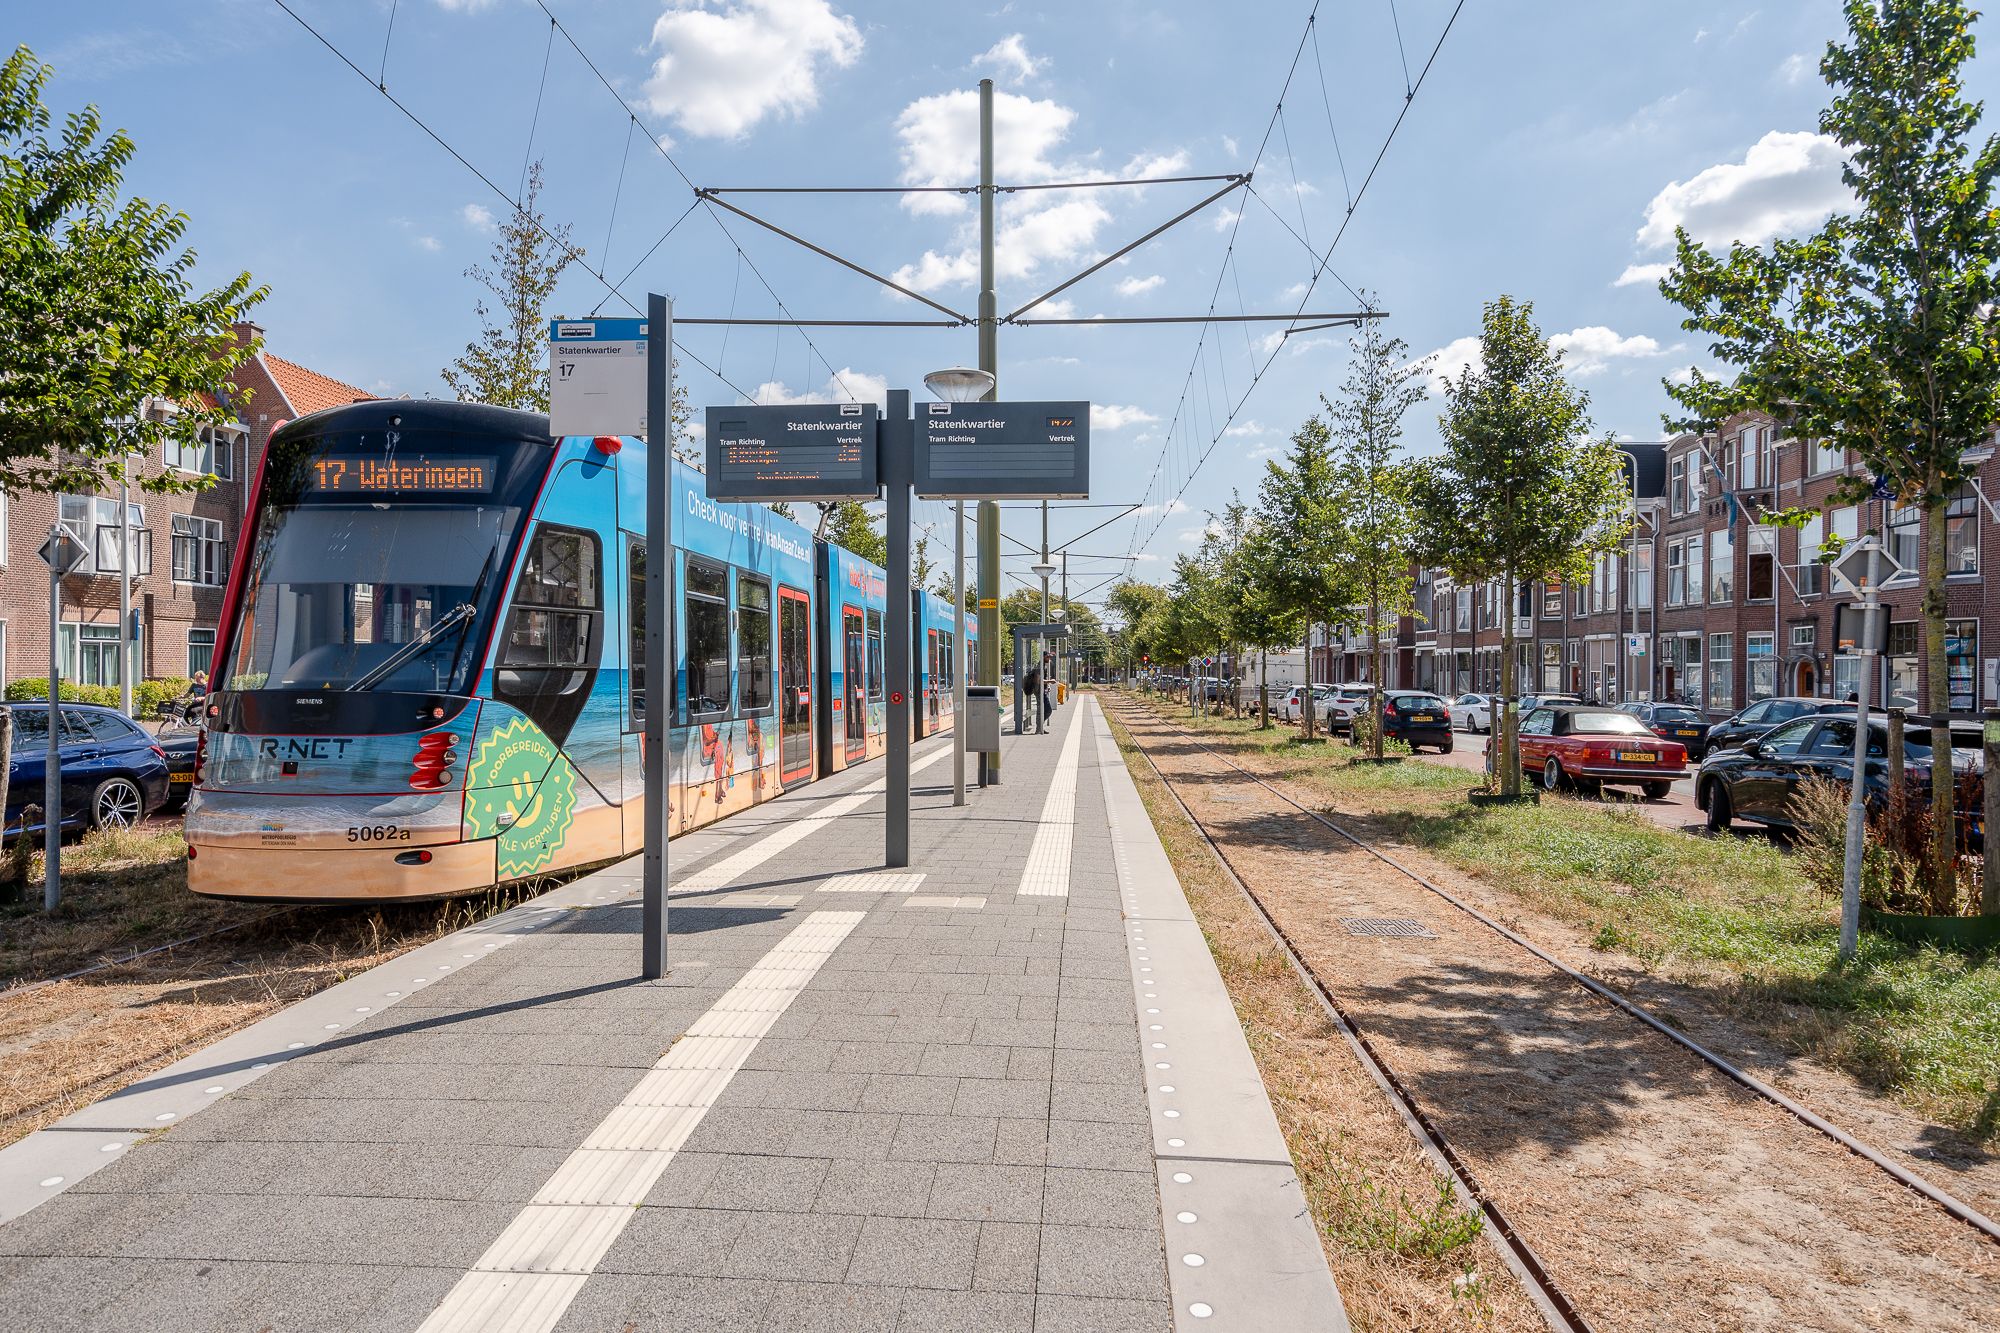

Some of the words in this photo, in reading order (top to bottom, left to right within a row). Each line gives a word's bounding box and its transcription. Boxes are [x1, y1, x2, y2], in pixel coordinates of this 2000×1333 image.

[559, 346, 621, 355] Statenkwartier
[559, 364, 575, 376] 17
[787, 421, 862, 431] Statenkwartier
[928, 420, 1006, 429] Statenkwartier
[738, 438, 766, 446] Richting
[948, 435, 976, 443] Richting
[314, 460, 347, 489] 17
[361, 460, 482, 489] Wateringen
[688, 490, 718, 524] Check
[718, 510, 737, 532] voor
[520, 792, 562, 852] VERMIJDEN
[347, 825, 410, 842] 5062a
